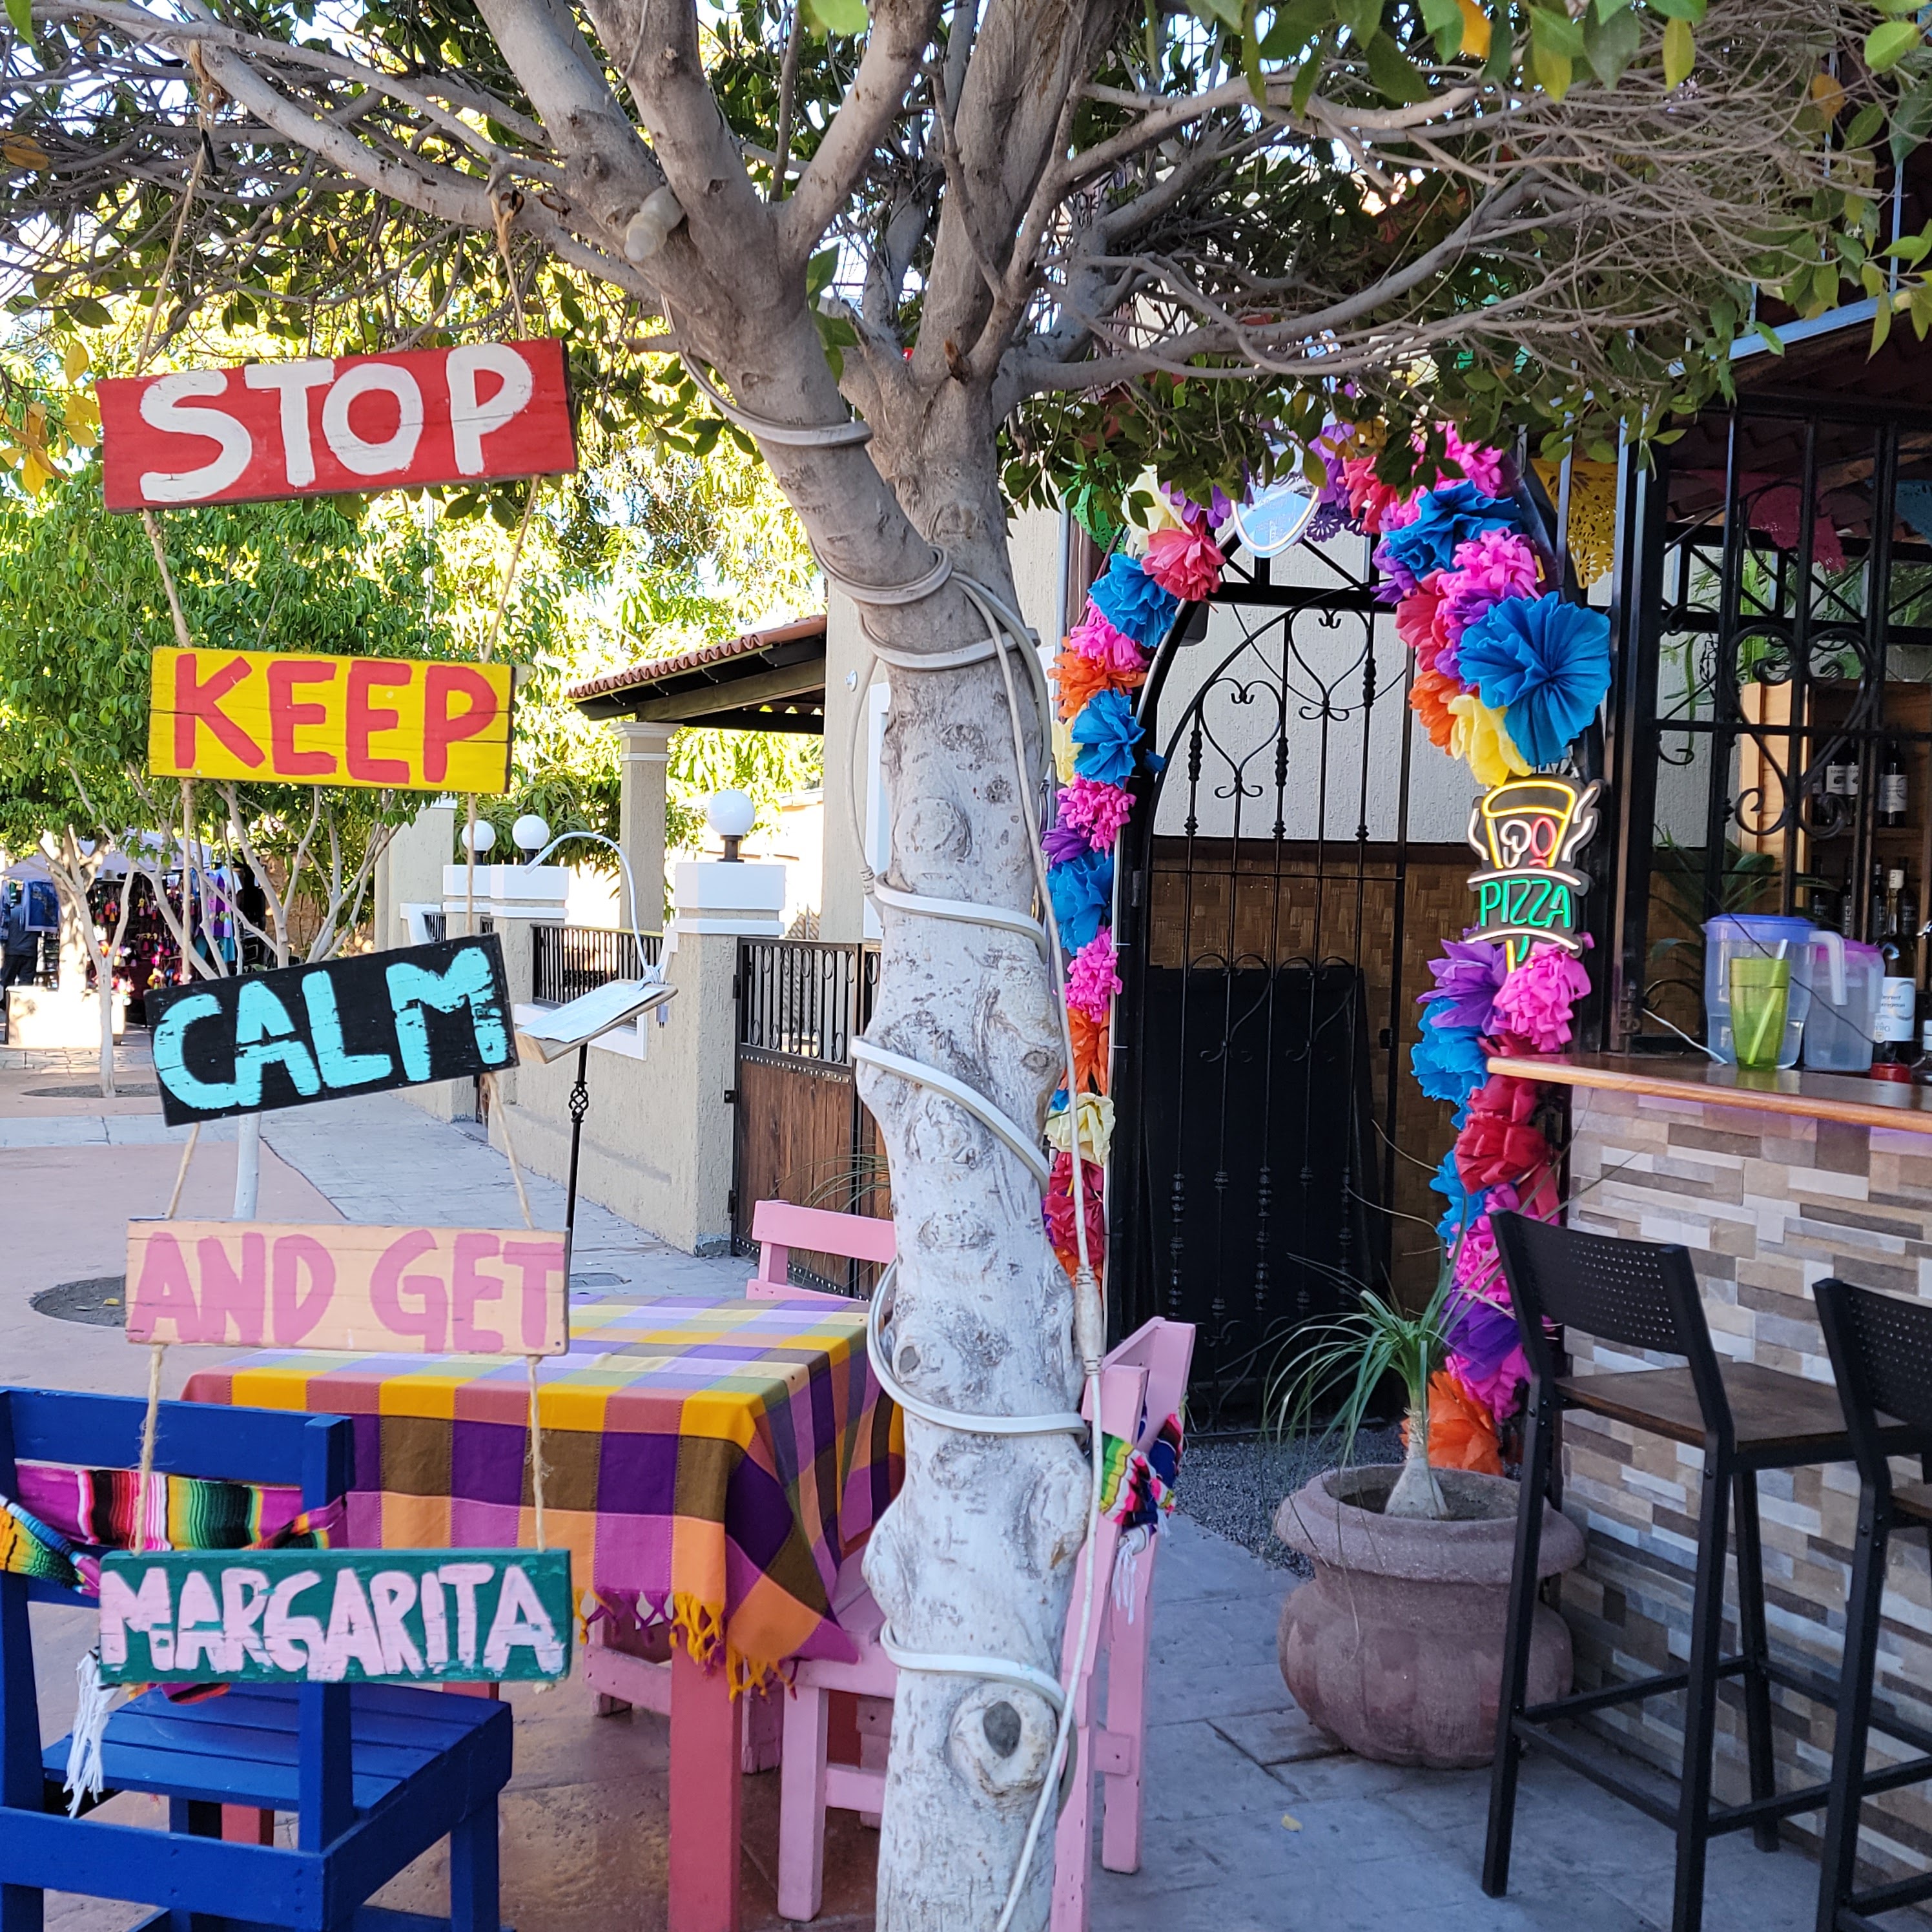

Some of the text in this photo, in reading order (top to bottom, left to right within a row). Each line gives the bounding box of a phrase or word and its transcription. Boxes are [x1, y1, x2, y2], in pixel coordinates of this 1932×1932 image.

[139, 342, 532, 502] STOP
[173, 653, 498, 784] KEEP
[1479, 879, 1572, 928] PIZZA
[153, 947, 509, 1110] CALM
[128, 1229, 566, 1353] AND GET
[99, 1562, 566, 1681] MARGARITA
